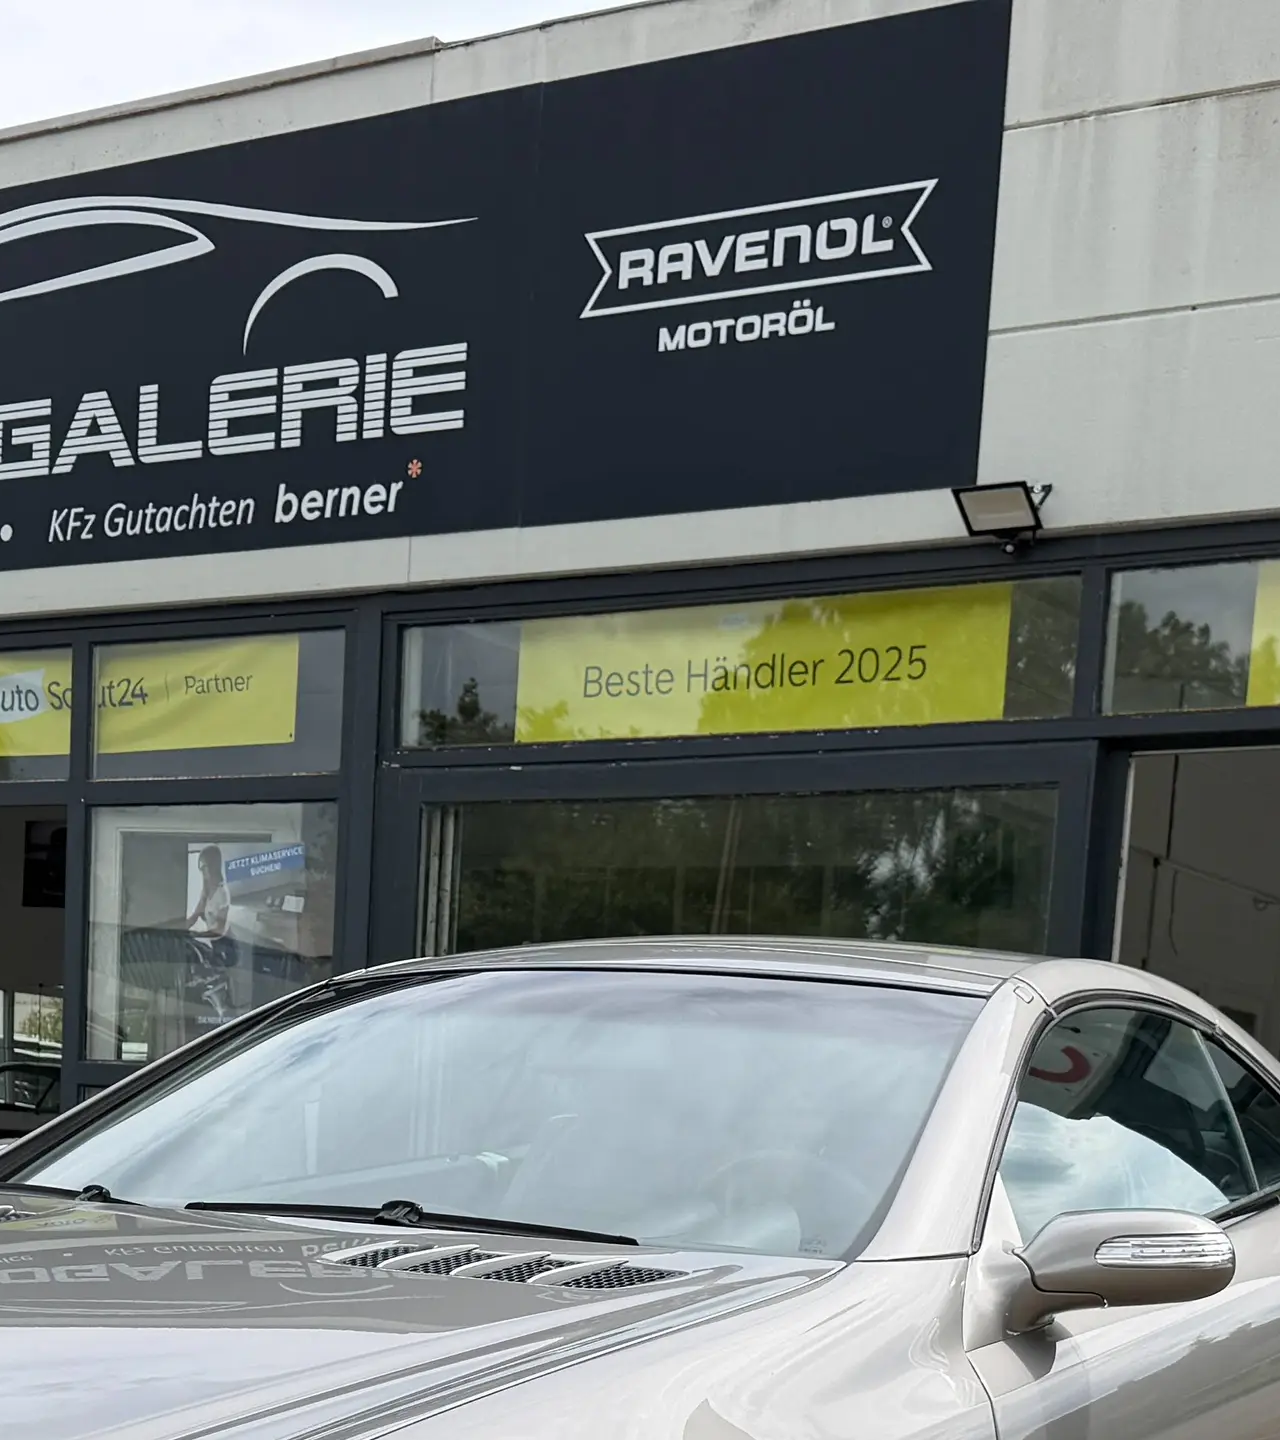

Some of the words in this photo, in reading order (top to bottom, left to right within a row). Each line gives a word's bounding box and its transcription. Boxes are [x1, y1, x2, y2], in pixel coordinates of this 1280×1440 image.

[618, 214, 894, 289] RAVENOL
[658, 299, 835, 352] MOTORÖL
[48, 507, 94, 542] KFz
[104, 493, 255, 538] Gutachten
[274, 478, 405, 523] berner
[184, 673, 253, 694] Partner
[583, 663, 674, 698] Beste
[686, 653, 825, 693] Händler
[835, 645, 927, 684] 2025
[228, 858, 250, 870] JETZT
[252, 847, 303, 864] KLIMASERVICE
